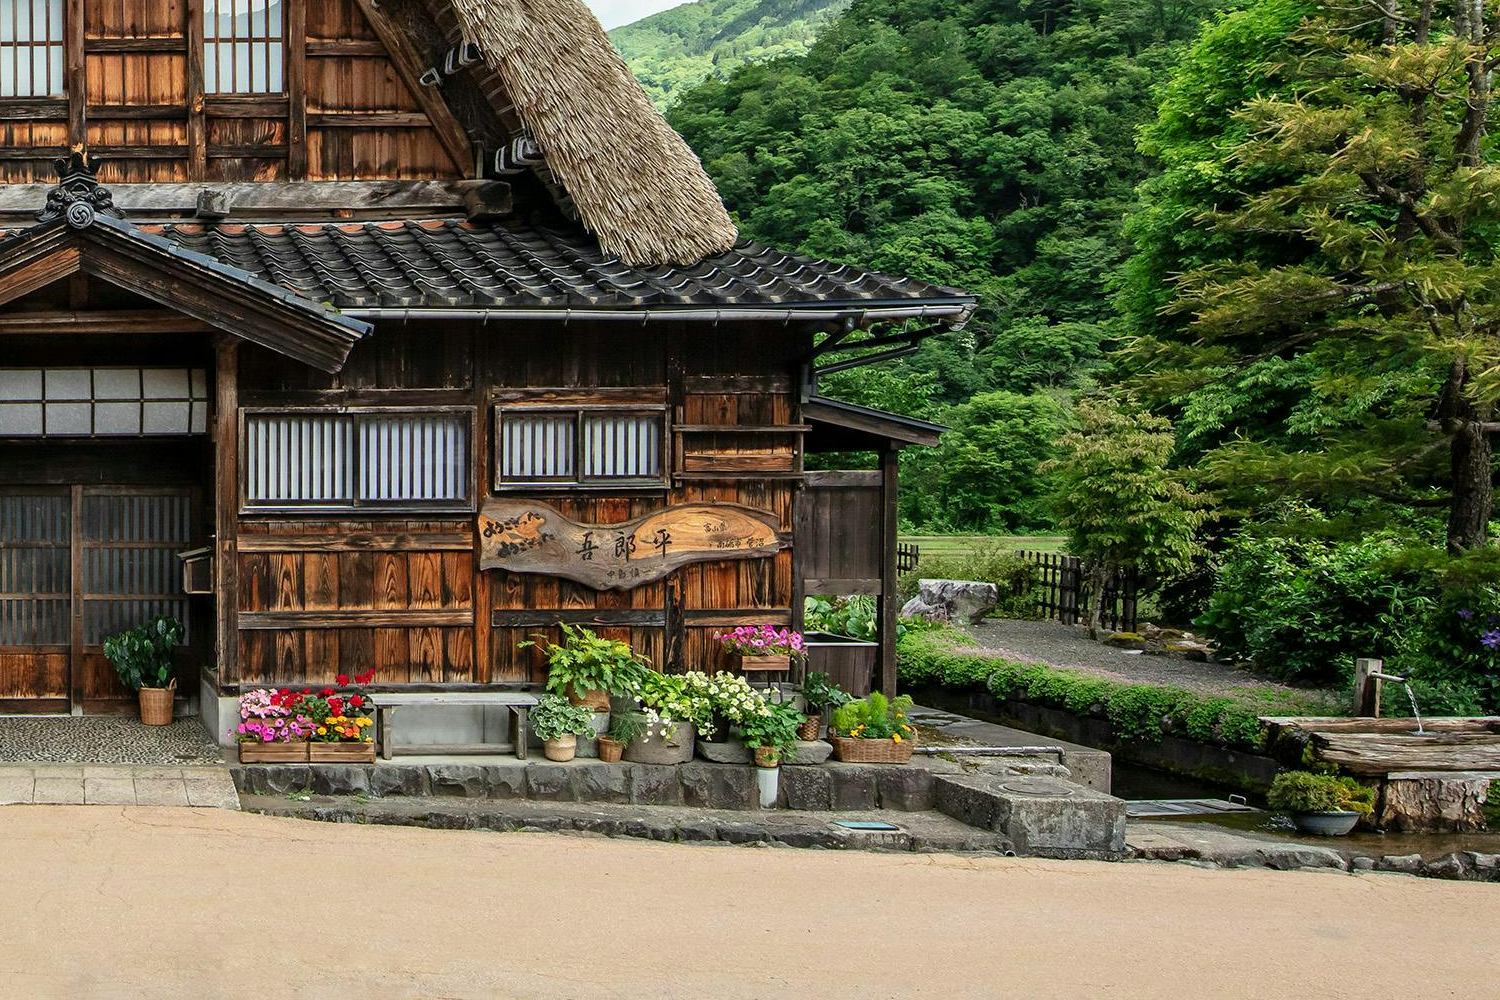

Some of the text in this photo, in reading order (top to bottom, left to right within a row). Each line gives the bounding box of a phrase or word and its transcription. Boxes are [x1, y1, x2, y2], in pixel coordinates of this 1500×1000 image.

[703, 521, 727, 533] 富山県
[575, 528, 673, 562] 吾郎平
